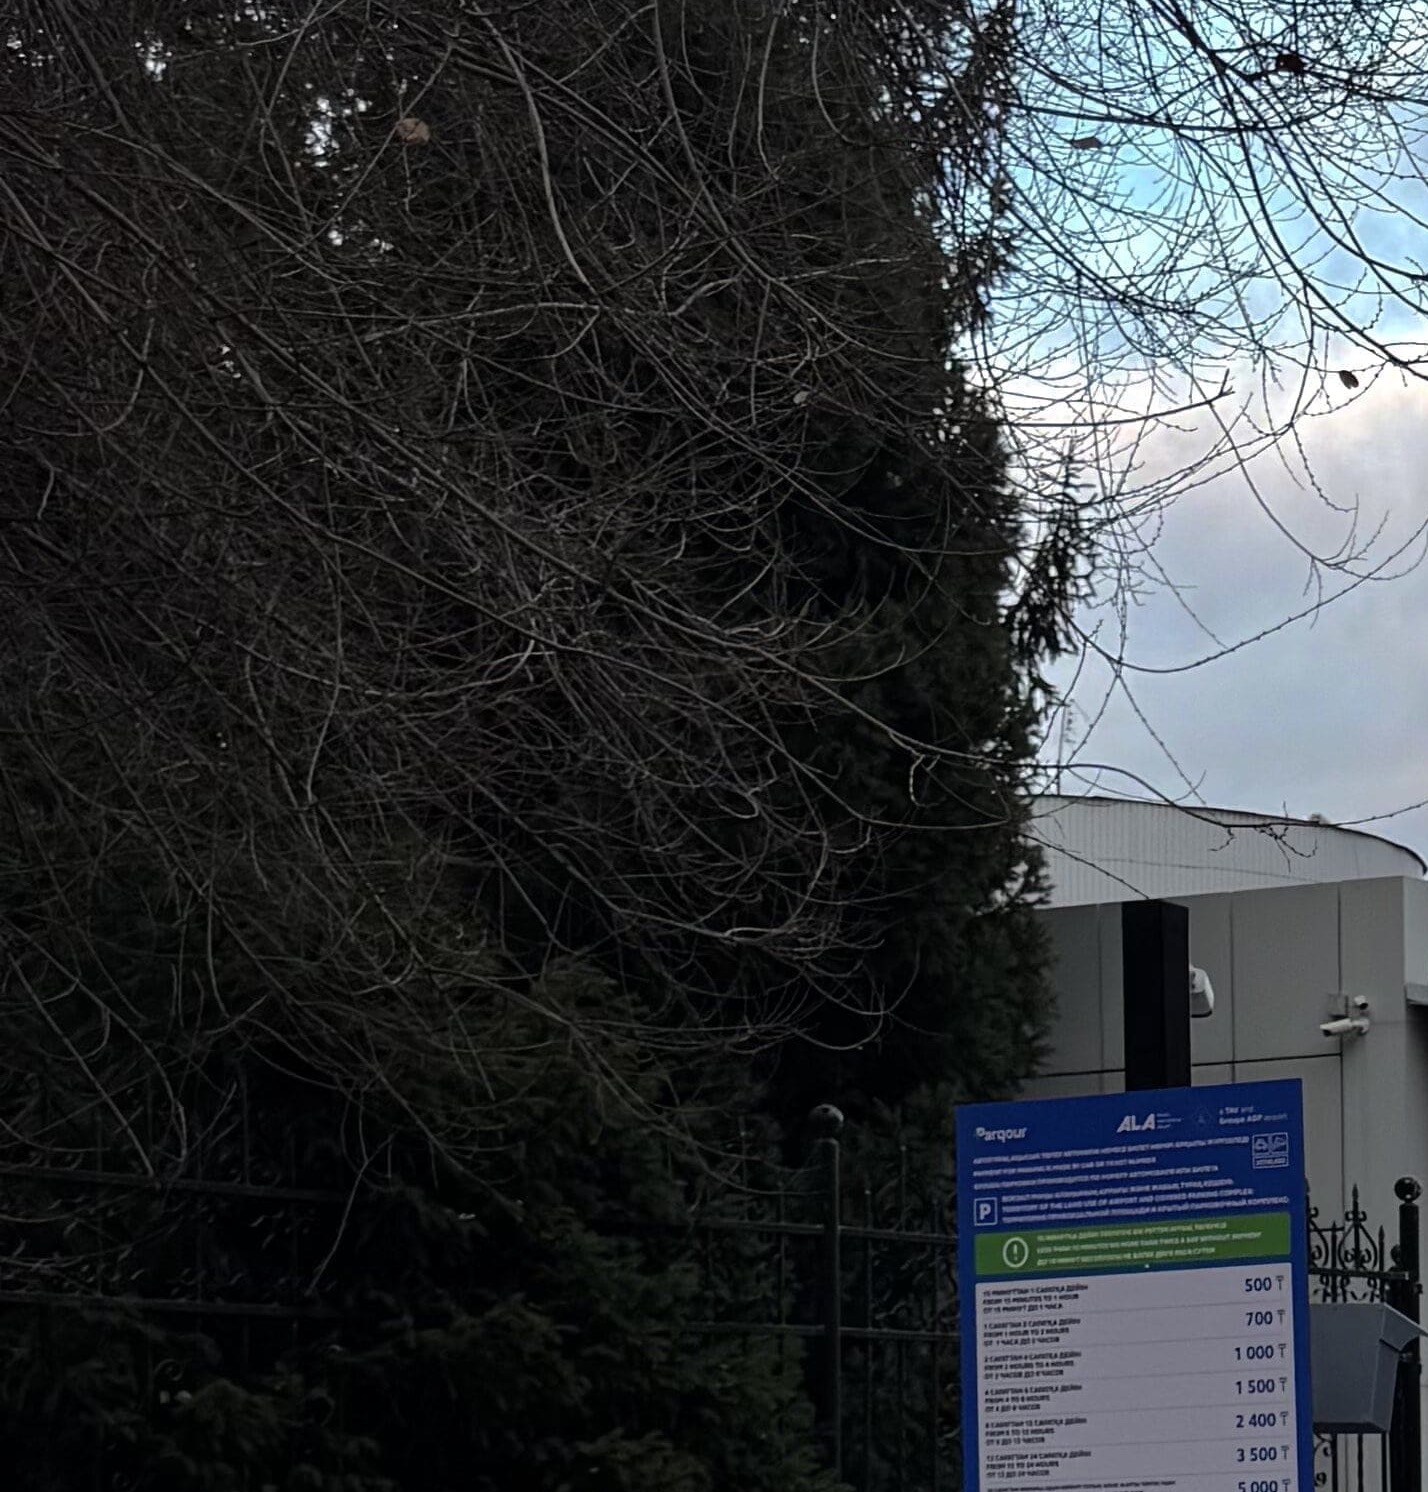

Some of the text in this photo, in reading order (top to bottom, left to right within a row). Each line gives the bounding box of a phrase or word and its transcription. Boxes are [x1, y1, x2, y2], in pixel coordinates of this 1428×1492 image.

[1116, 1114, 1155, 1133] ALA
[976, 1127, 1028, 1143] Parqour
[1245, 1277, 1272, 1293] 500
[1246, 1311, 1273, 1326] 700
[1235, 1347, 1241, 1360] 1
[1246, 1345, 1274, 1360] 000
[1236, 1381, 1242, 1394] 1
[1247, 1378, 1275, 1394] 500
[1236, 1416, 1246, 1428] 2
[1250, 1413, 1276, 1427] 400
[1236, 1449, 1246, 1462] 3
[1250, 1446, 1277, 1461] 500
